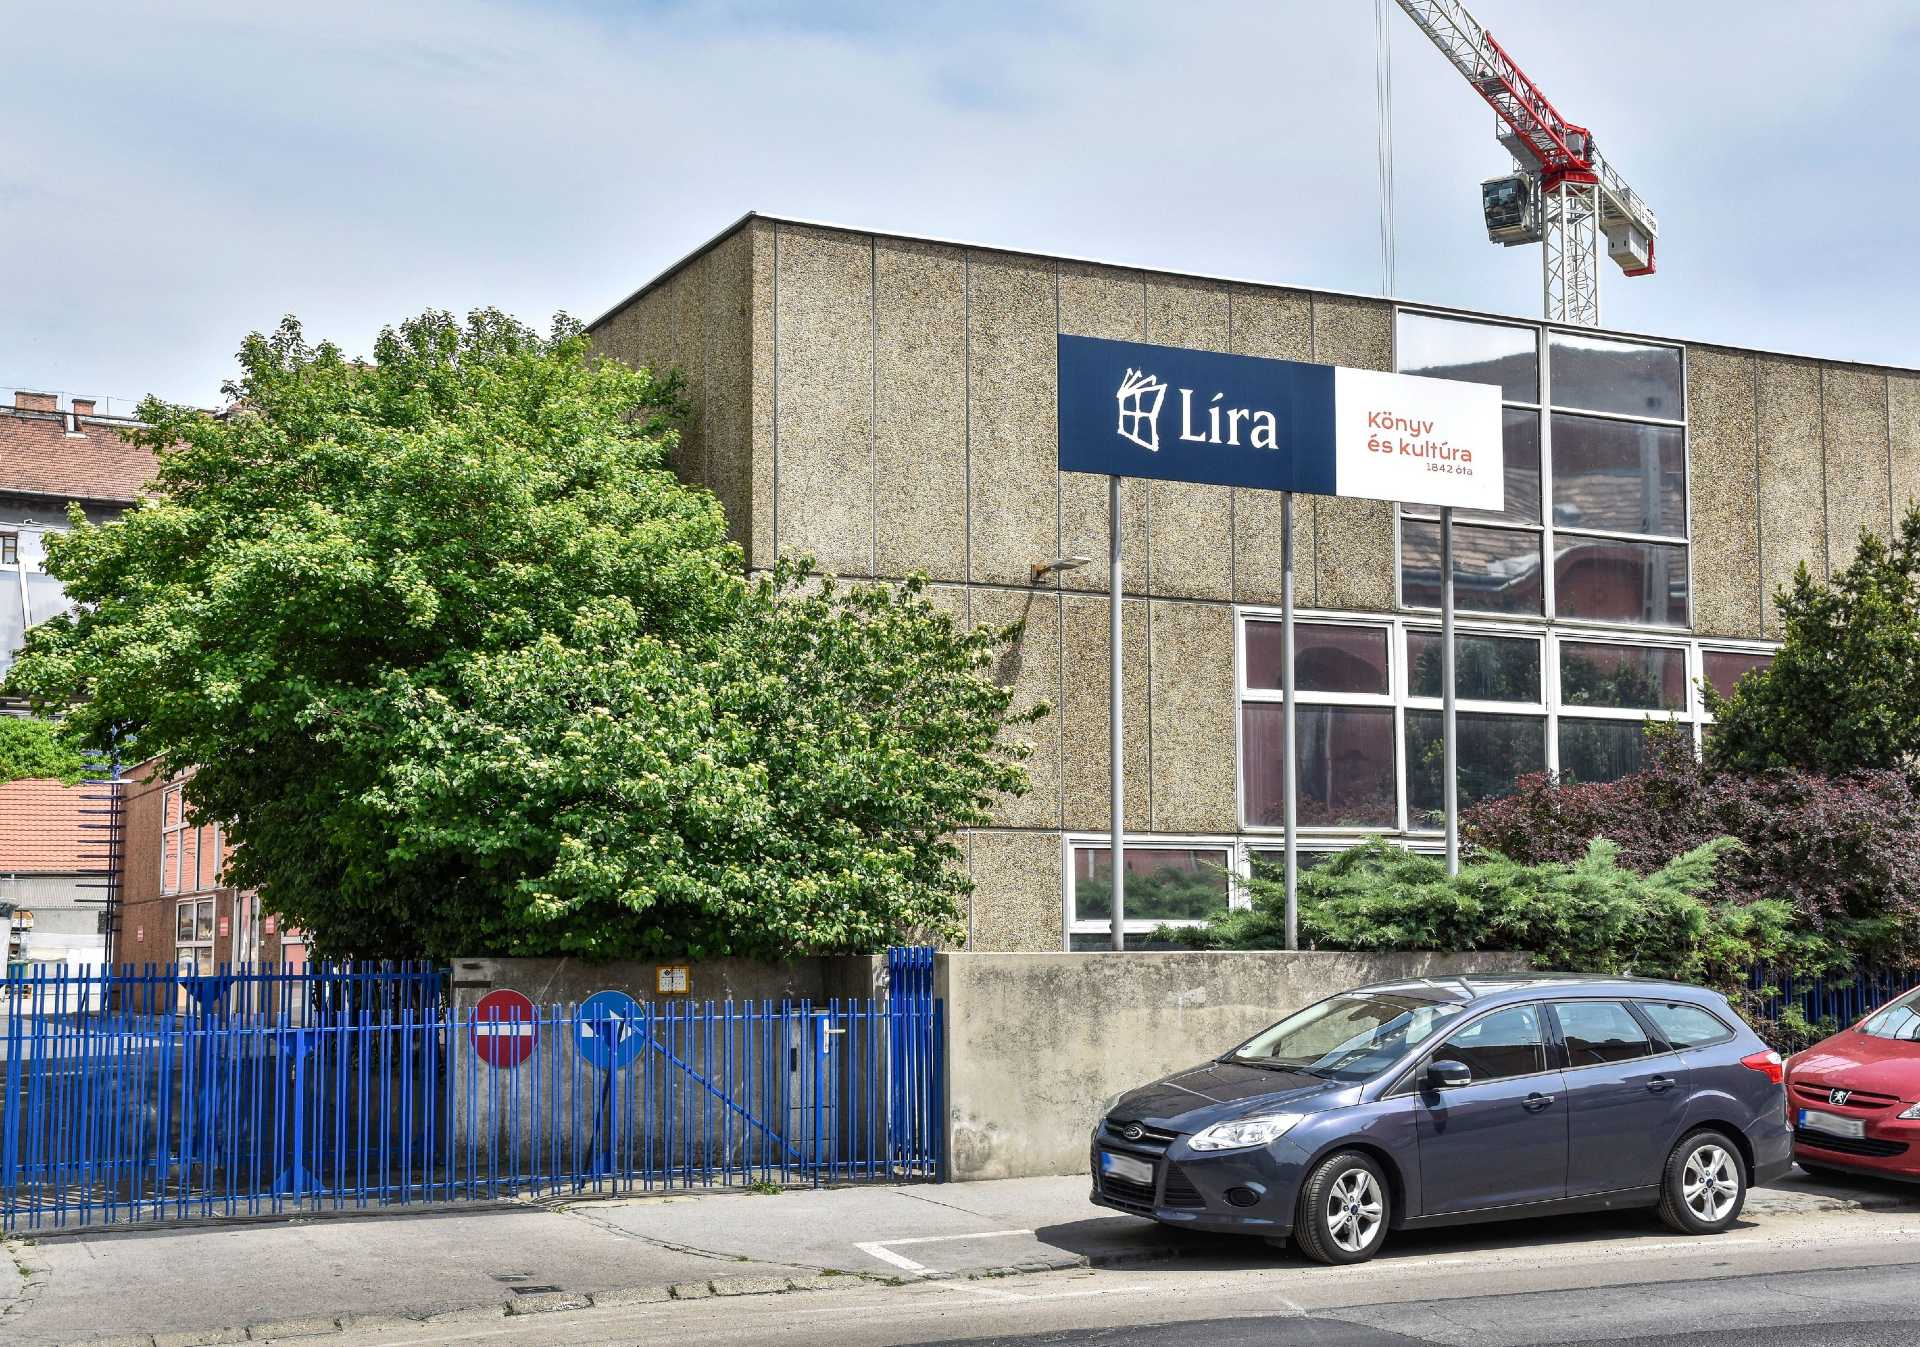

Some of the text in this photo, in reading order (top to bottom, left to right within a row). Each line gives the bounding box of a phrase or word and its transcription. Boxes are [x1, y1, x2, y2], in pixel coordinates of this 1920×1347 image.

[1179, 388, 1279, 449] Líra
[1368, 411, 1434, 437] Könyv
[1367, 433, 1472, 462] és kultúra
[1426, 462, 1453, 474] 1842
